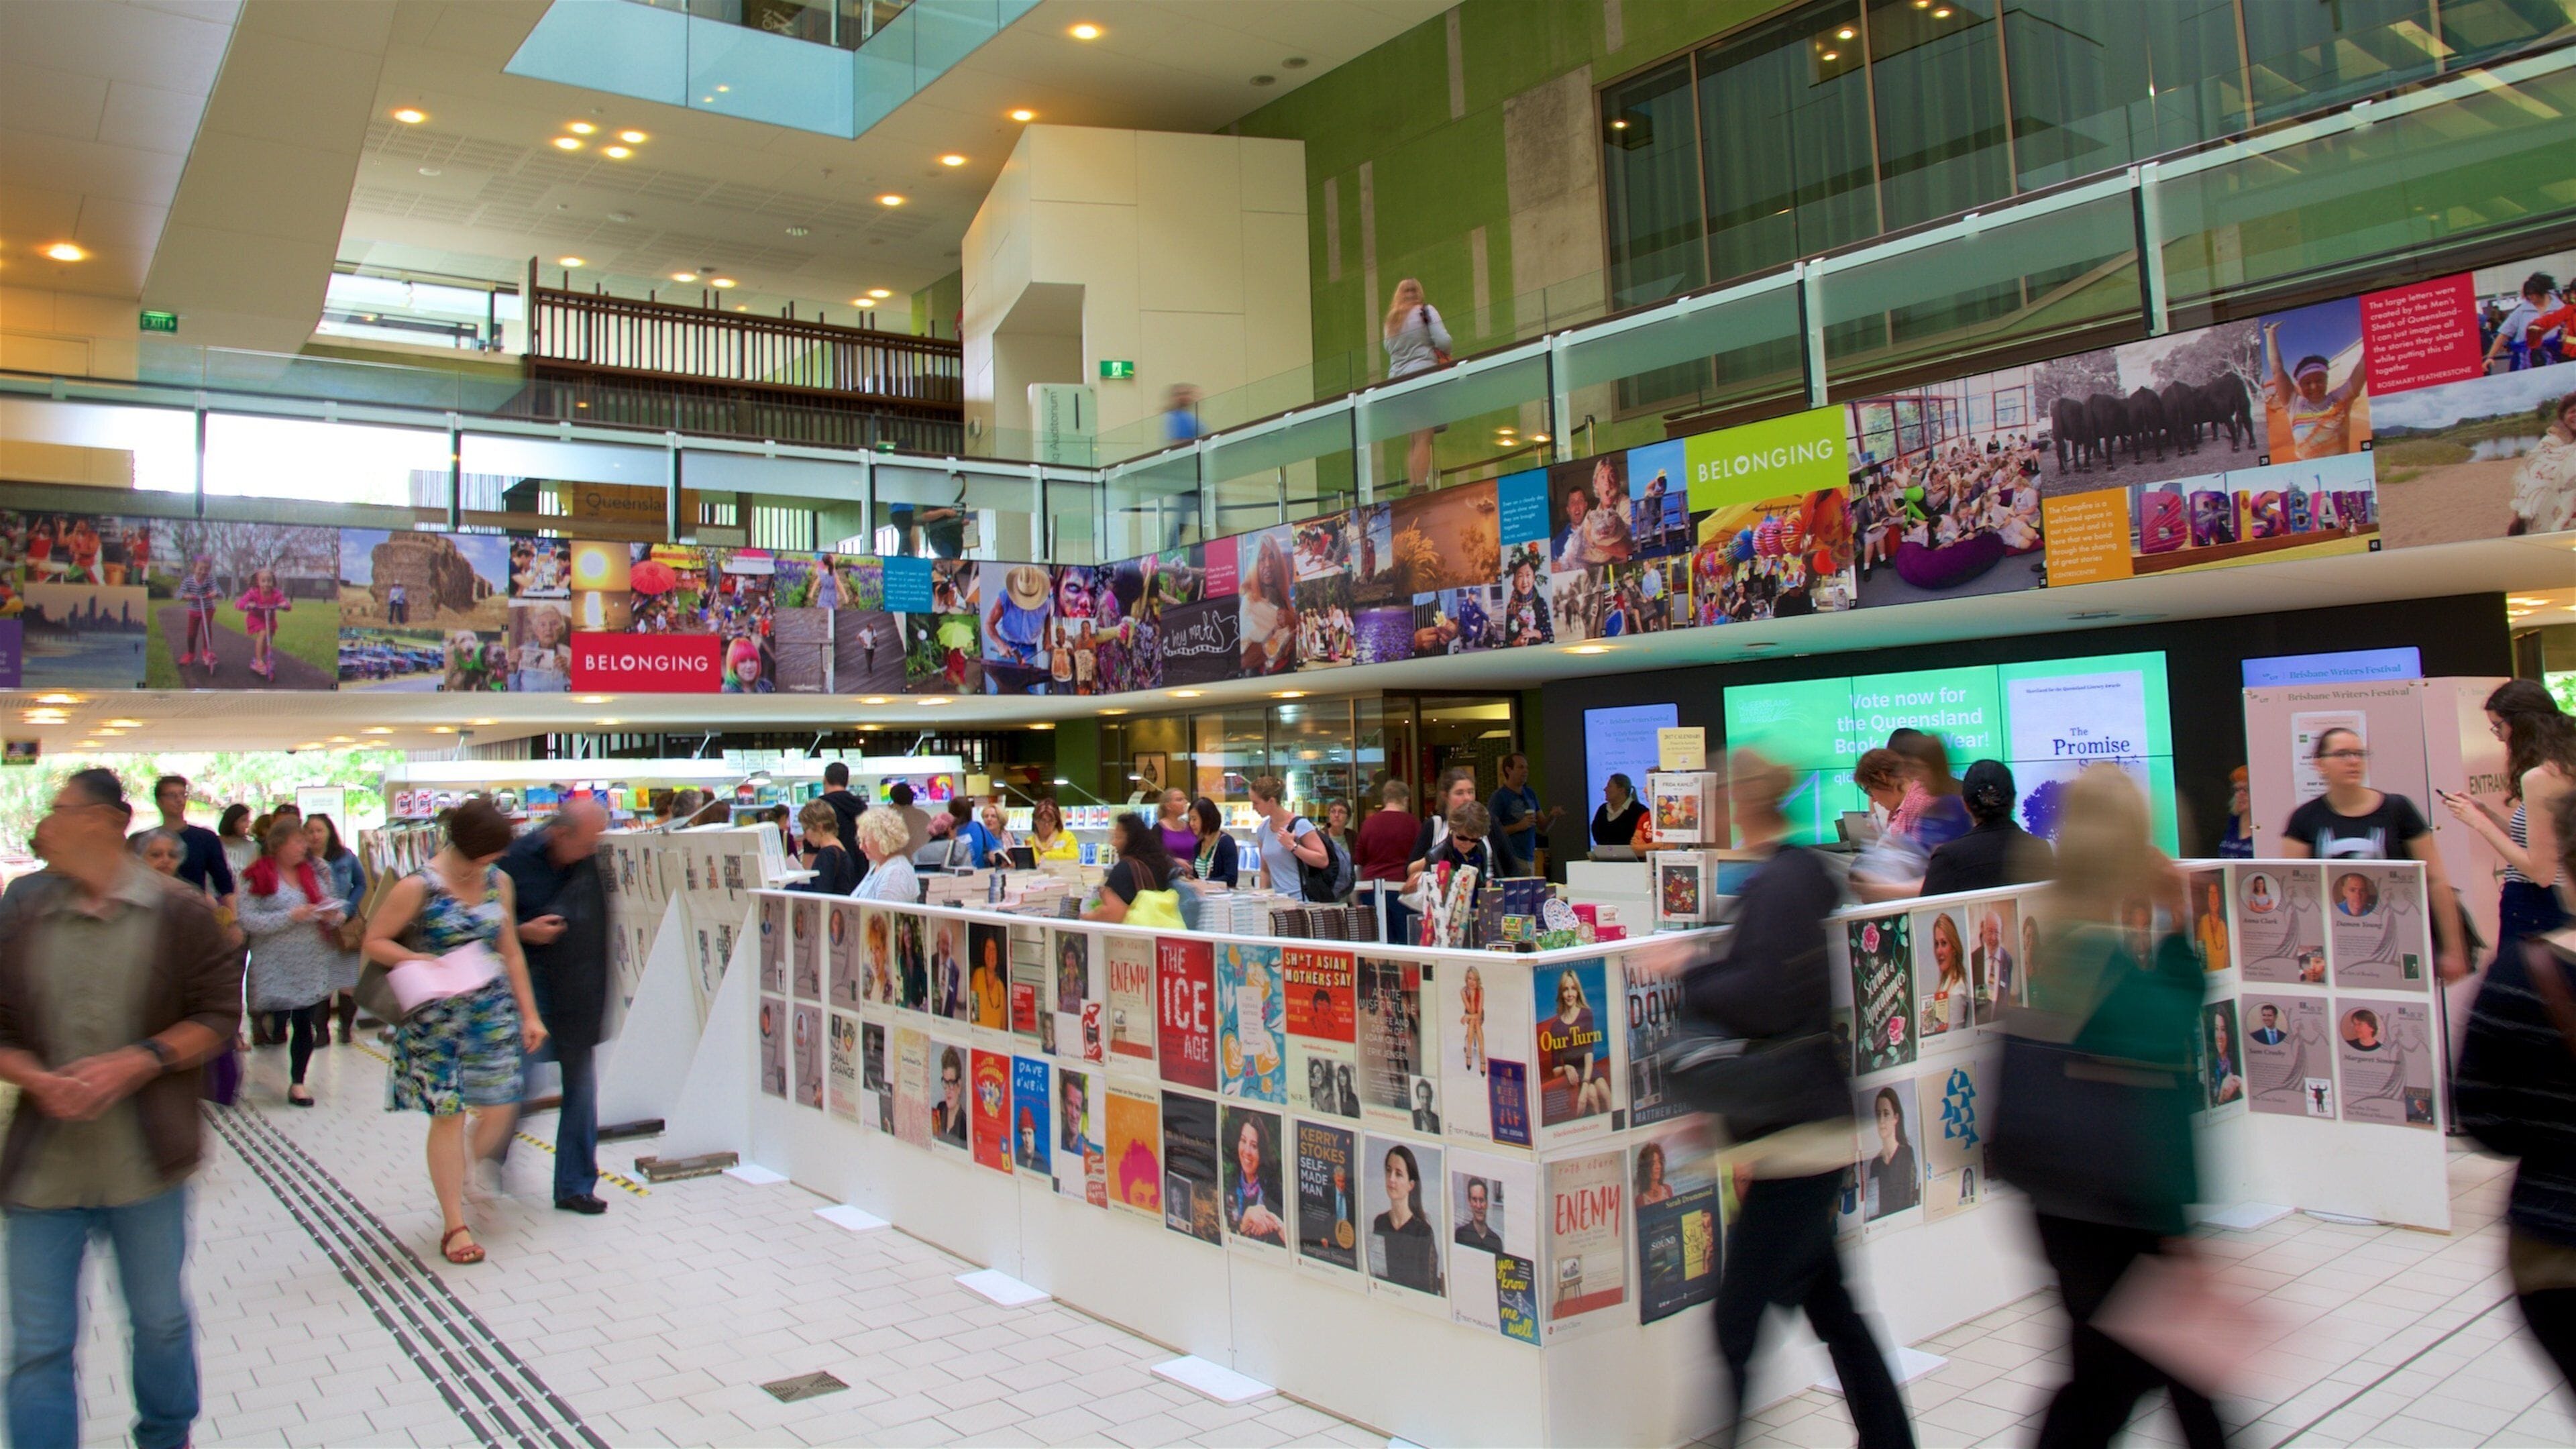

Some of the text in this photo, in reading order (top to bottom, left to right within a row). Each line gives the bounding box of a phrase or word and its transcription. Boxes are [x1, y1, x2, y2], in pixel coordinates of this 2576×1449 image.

[2385, 297, 2406, 306] large
[2408, 292, 2433, 301] letters
[2435, 287, 2456, 295] were
[2370, 309, 2400, 321] created
[2402, 307, 2412, 315] by
[2430, 298, 2455, 308] Men's
[2371, 321, 2395, 331] Sheds
[2398, 319, 2406, 327] of
[2377, 333, 2392, 341] can
[2394, 331, 2408, 339] just
[2410, 325, 2441, 335] imagine
[2444, 319, 2455, 328] all
[2373, 329, 2464, 354] the stories they shared
[2375, 355, 2396, 364] while
[2398, 350, 2425, 362] putting
[2444, 342, 2454, 351] all
[2375, 364, 2409, 376] together
[2377, 366, 2472, 389] ROSEMARY FEATHERSTONE
[1698, 439, 1833, 483] BELONGING
[586, 492, 666, 516] Queensla
[2062, 502, 2093, 512] Campfire
[2049, 514, 2083, 524] well-loved
[2084, 513, 2104, 521] space
[2063, 524, 2085, 534] school
[2087, 522, 2100, 530] and
[2094, 531, 2112, 540] bond
[2051, 546, 2077, 556] through
[2092, 543, 2117, 551] sharing
[2053, 555, 2102, 567] of great stories
[585, 653, 708, 672] BELONGING
[2330, 668, 2364, 676] Writers
[2365, 664, 2402, 674] Festival
[1849, 687, 1967, 709] Vote now for
[2288, 687, 2410, 702] Brisbane Writers Festival
[1837, 708, 1983, 733] the Queensland
[2070, 727, 2088, 737] The
[1835, 731, 1990, 754] Book Year!
[2053, 736, 2131, 755] Promise
[2469, 773, 2509, 795] ENTRAN
[2261, 917, 2277, 925] Clark
[2362, 921, 2383, 930] Young
[1161, 945, 1186, 974] THE
[1317, 956, 1347, 971] ASIAN
[1110, 960, 1150, 1006] ENEMY
[1285, 969, 1352, 987] MOTHERS SAY
[1864, 963, 1889, 1000] Science
[1372, 987, 1401, 1001] ACUTE
[1163, 977, 1208, 1033] ICE
[1358, 998, 1416, 1015] MISFORTUNE
[1629, 985, 1681, 1029] DOW
[1366, 1014, 1409, 1028] THE LIFE AND
[1371, 1024, 1403, 1036] DEATH OF
[1364, 1034, 1411, 1046] ADAM CULLEN
[1540, 1026, 1602, 1052] Our Turn
[1184, 1034, 1209, 1063] AGE
[1366, 1046, 1407, 1061] ERIK JENSEN
[831, 1052, 849, 1066] SMALL
[2344, 1054, 2375, 1064] Margaret
[830, 1063, 855, 1080] CHANGE
[1018, 1061, 1044, 1078] DAVE
[1635, 1106, 1672, 1124] MATTHEW
[1300, 1127, 1339, 1147] KERRY
[1300, 1142, 1346, 1165] STOKES
[1300, 1157, 1328, 1171] SELF-
[1300, 1170, 1328, 1186] MADE
[1301, 1181, 1324, 1197] MAN
[1665, 1187, 1713, 1209] Sarah Drummond
[1554, 1183, 1620, 1238] ENEMY
[1497, 1258, 1515, 1280] you
[1501, 1275, 1527, 1291] know
[1501, 1307, 1519, 1322] me
[1508, 1318, 1534, 1338] well
